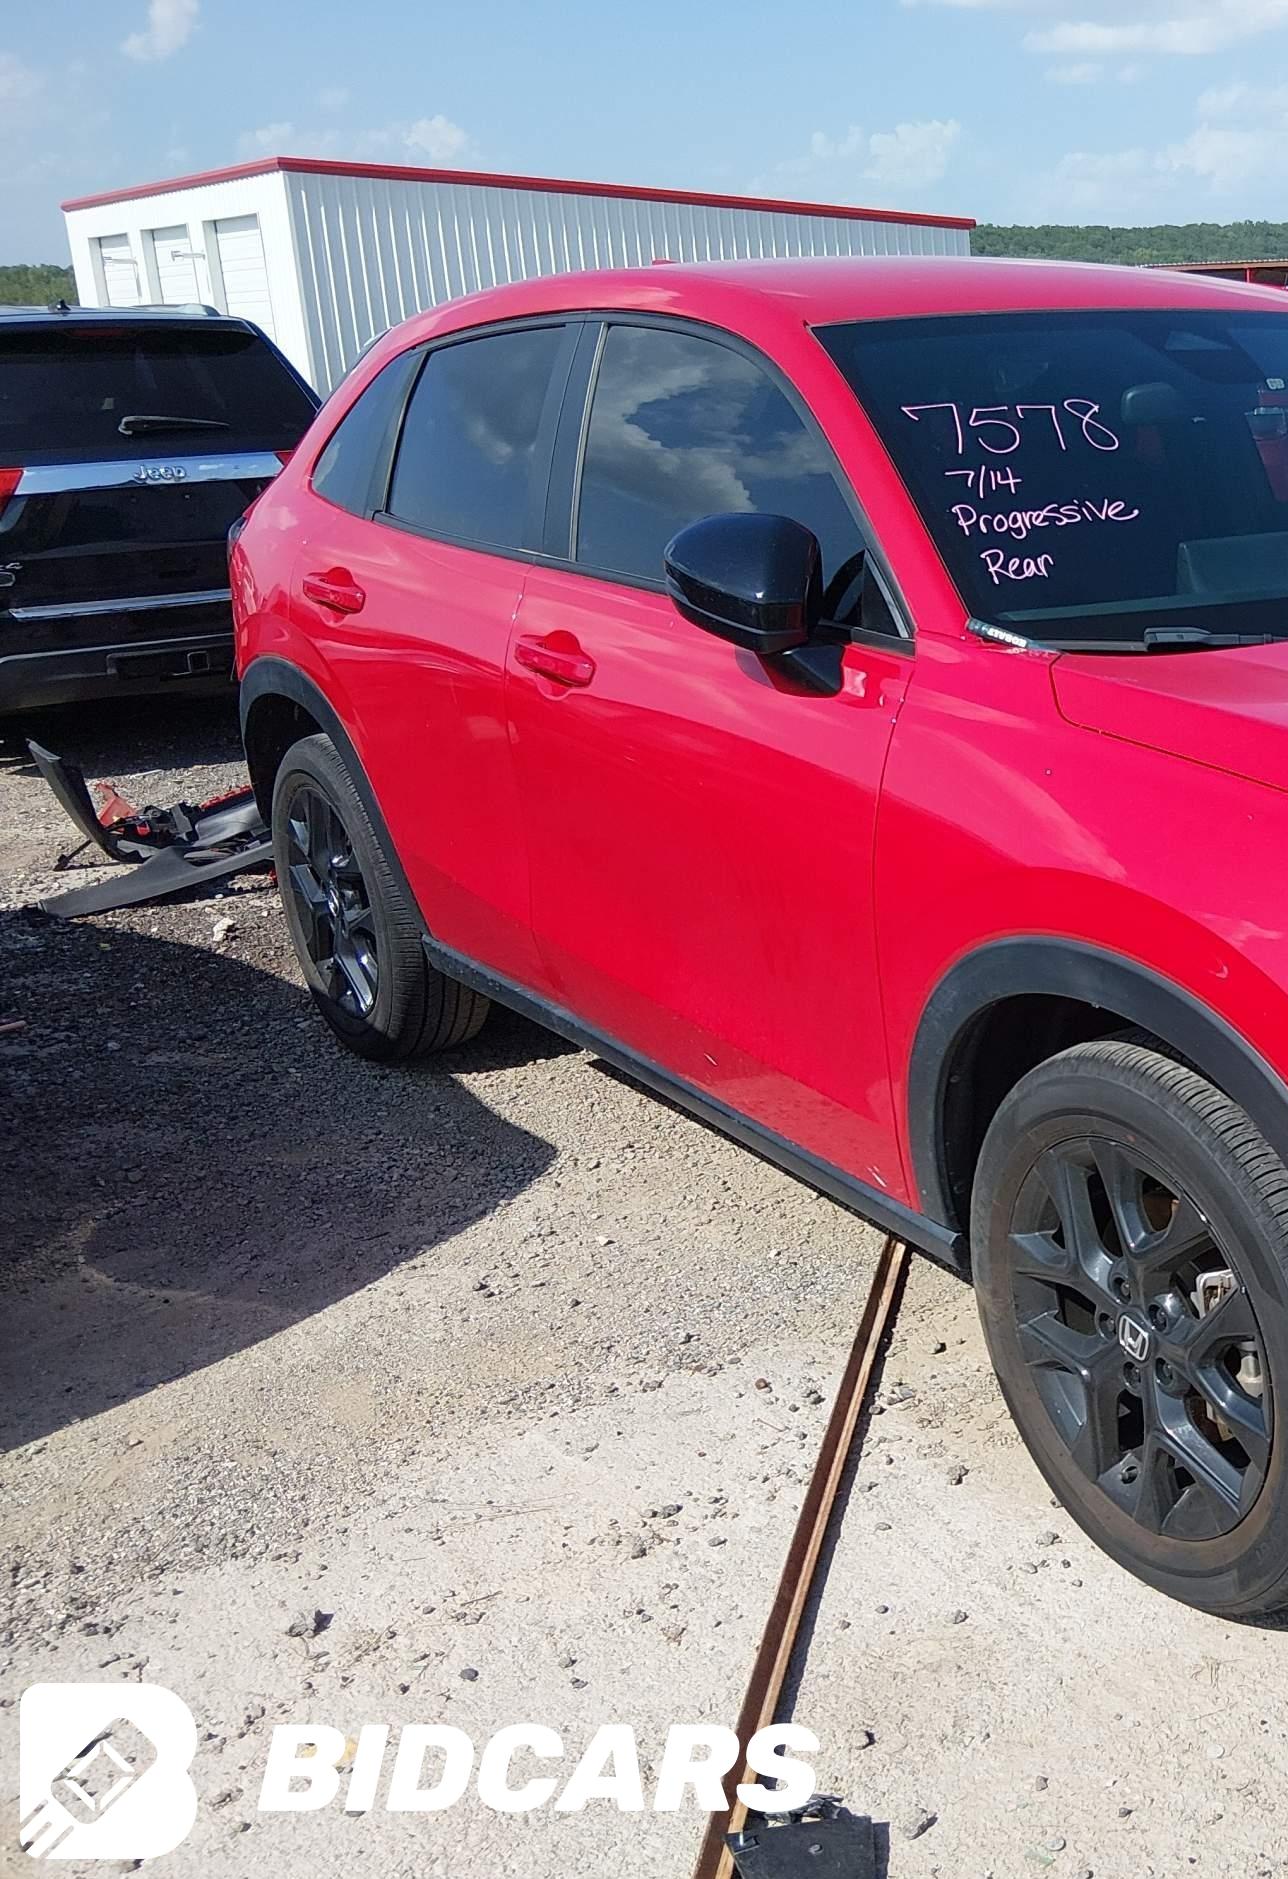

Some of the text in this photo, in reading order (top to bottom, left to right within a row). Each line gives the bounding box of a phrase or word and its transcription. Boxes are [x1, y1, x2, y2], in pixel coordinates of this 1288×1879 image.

[901, 399, 1118, 454] 7578
[133, 464, 187, 483] Jeep
[944, 465, 1022, 499] 7/14
[951, 499, 1139, 539] Progressive
[980, 549, 1054, 584] Rear
